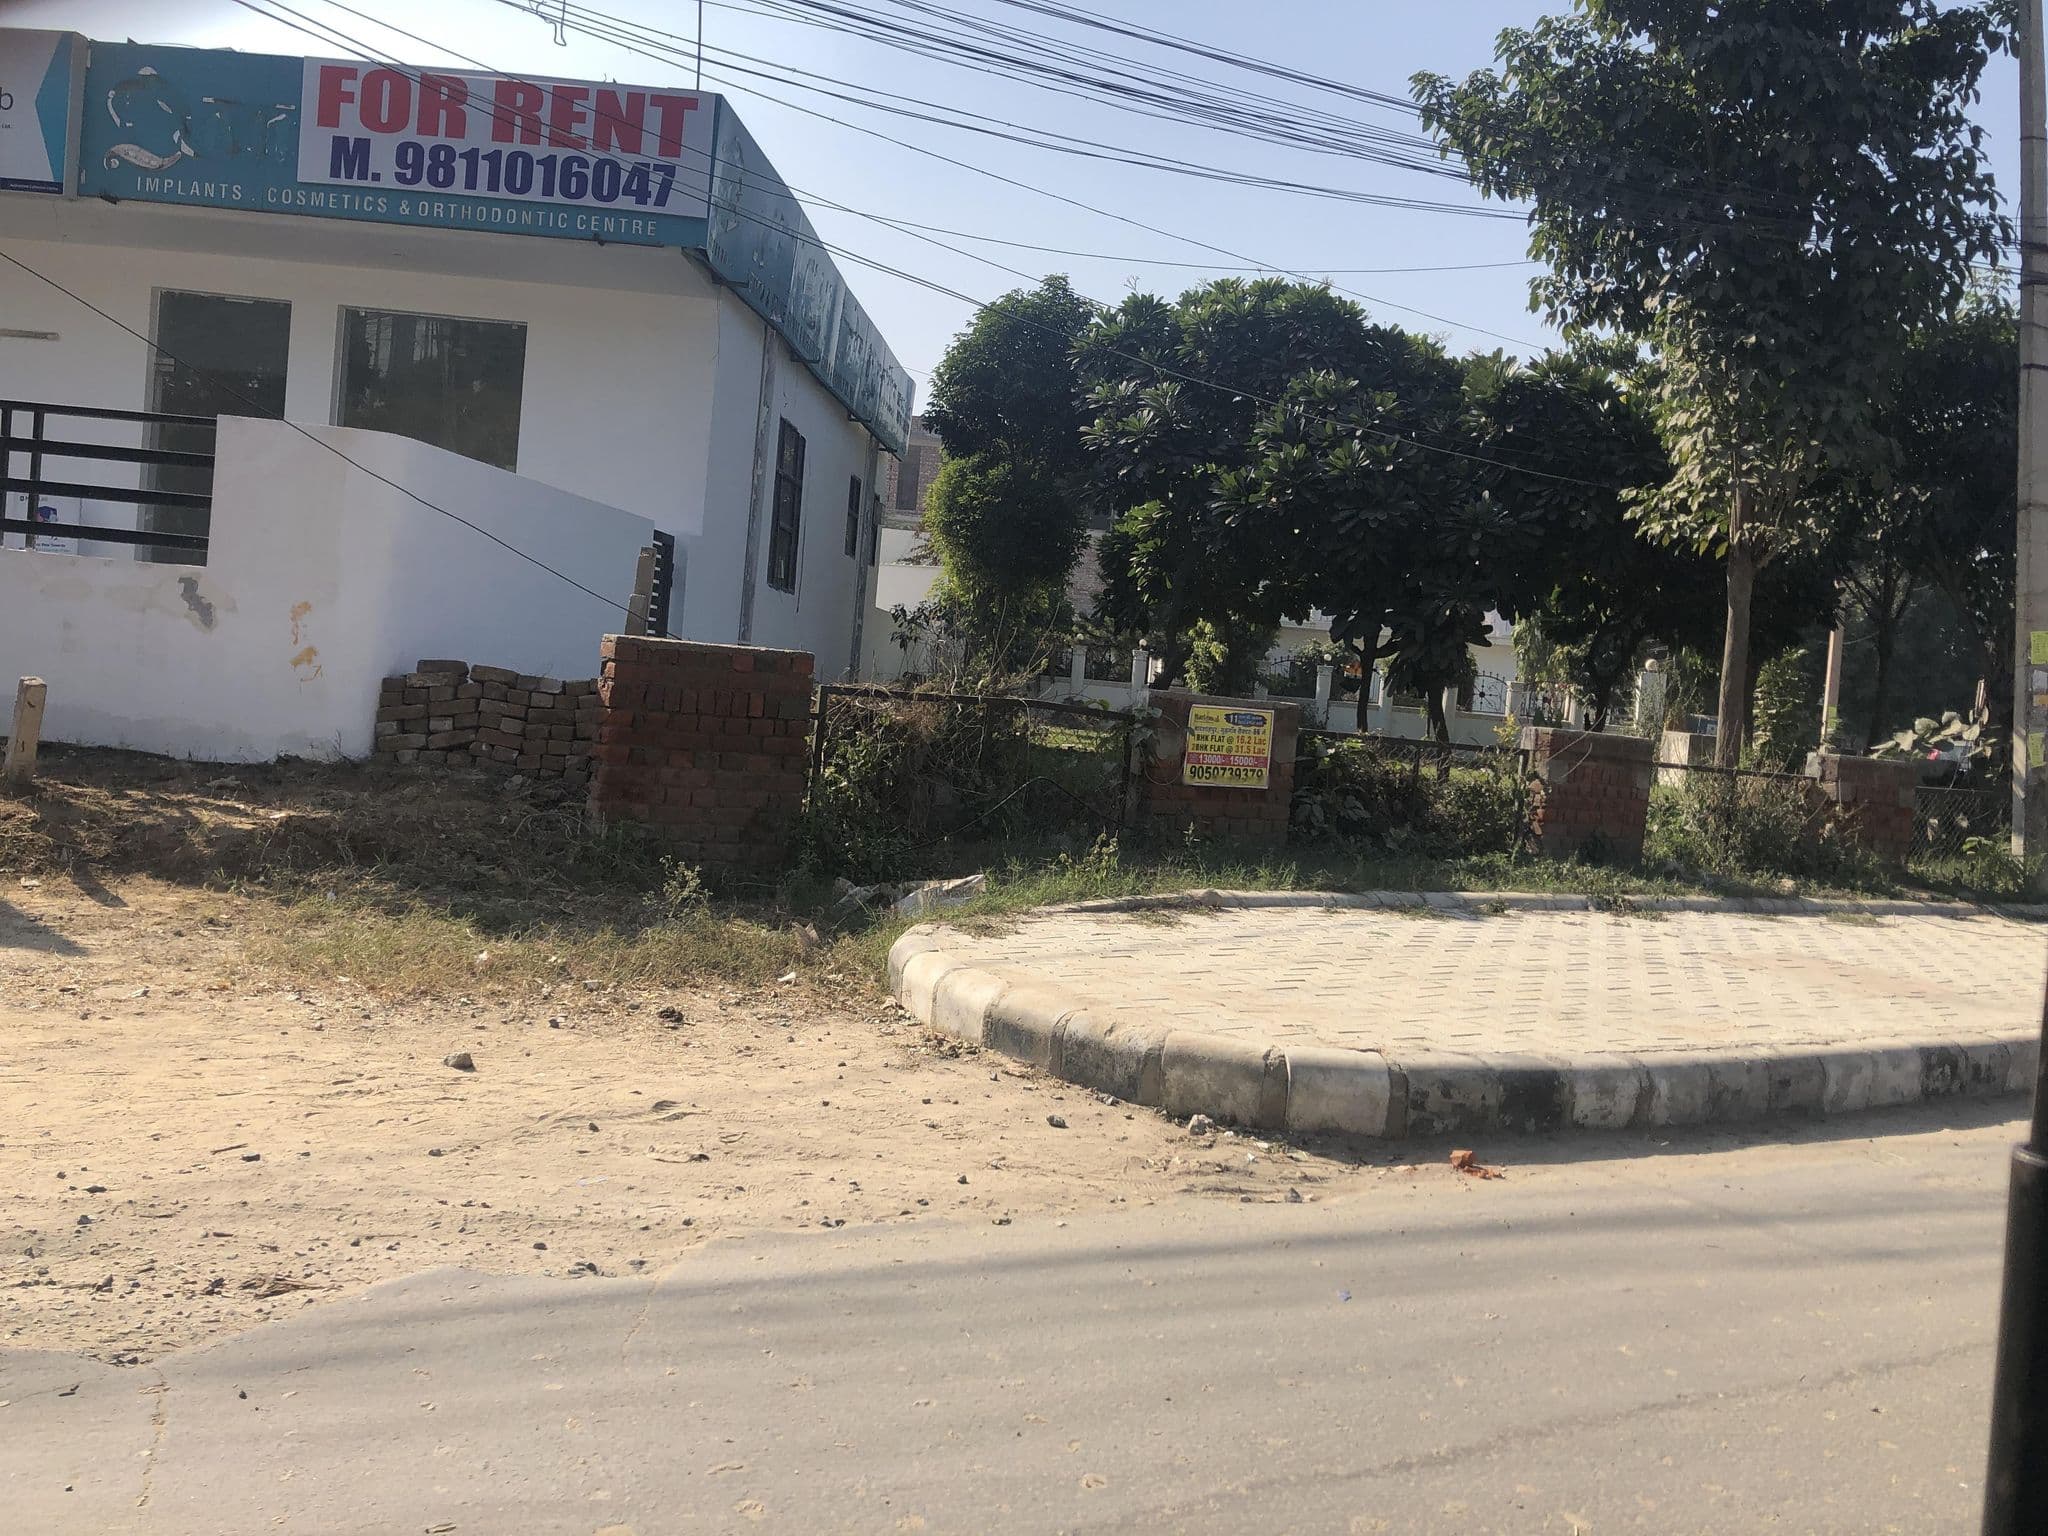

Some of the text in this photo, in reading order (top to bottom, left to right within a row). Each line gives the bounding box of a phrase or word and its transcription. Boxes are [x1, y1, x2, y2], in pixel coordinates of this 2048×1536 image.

[317, 65, 699, 158] FOR RENT
[329, 135, 676, 207] M. 9811016047
[136, 176, 657, 236] IMPLANTS COSMETICS & ORTHODONTIC CENTRE
[1210, 744, 1224, 752] FLAT
[1211, 735, 1226, 743] FLAT
